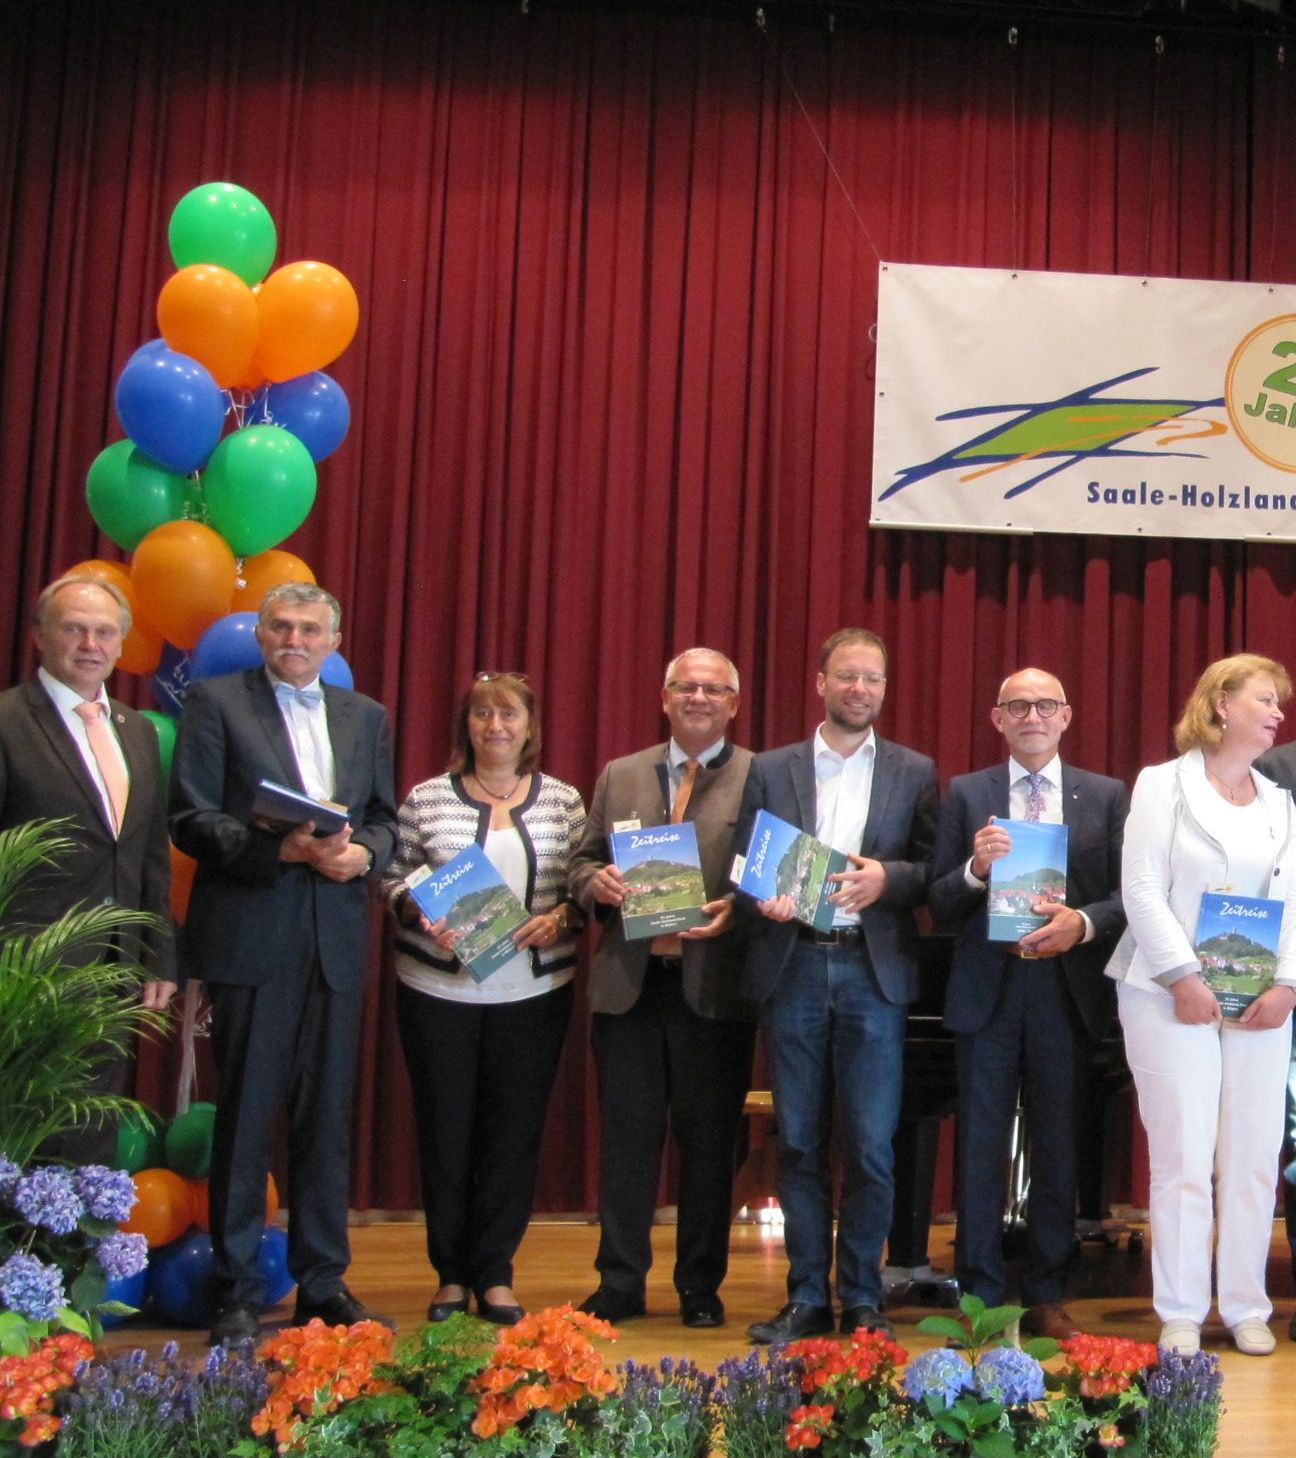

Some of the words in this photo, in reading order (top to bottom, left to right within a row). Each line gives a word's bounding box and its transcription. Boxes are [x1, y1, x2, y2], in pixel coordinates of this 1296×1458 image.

[630, 832, 681, 849] Zeitreise
[751, 828, 772, 878] Zeitreise
[430, 860, 474, 896] Zeitreise
[1219, 902, 1270, 919] Zeitreise
